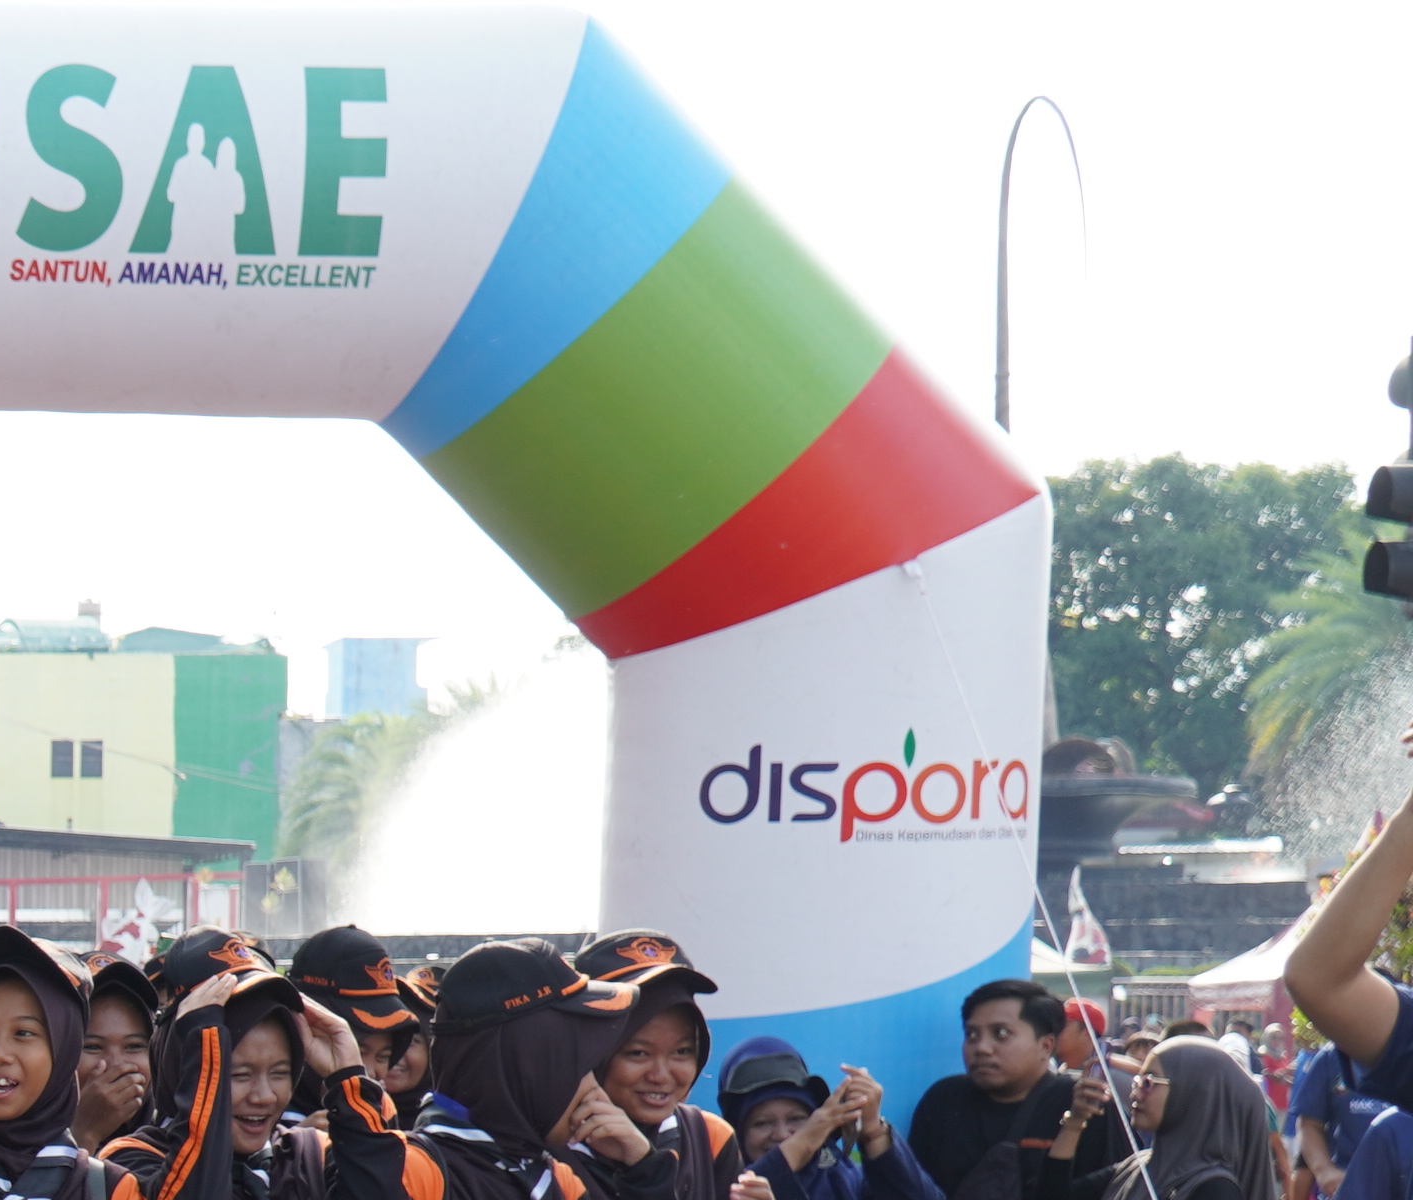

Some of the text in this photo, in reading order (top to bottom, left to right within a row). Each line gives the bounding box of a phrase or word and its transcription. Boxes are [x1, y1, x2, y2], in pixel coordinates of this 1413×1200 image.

[16, 62, 387, 258] SAE
[9, 258, 377, 290] SANTUN, AMANAH, EXCELLENT
[699, 743, 1029, 843] dispora
[855, 828, 894, 842] Dinas
